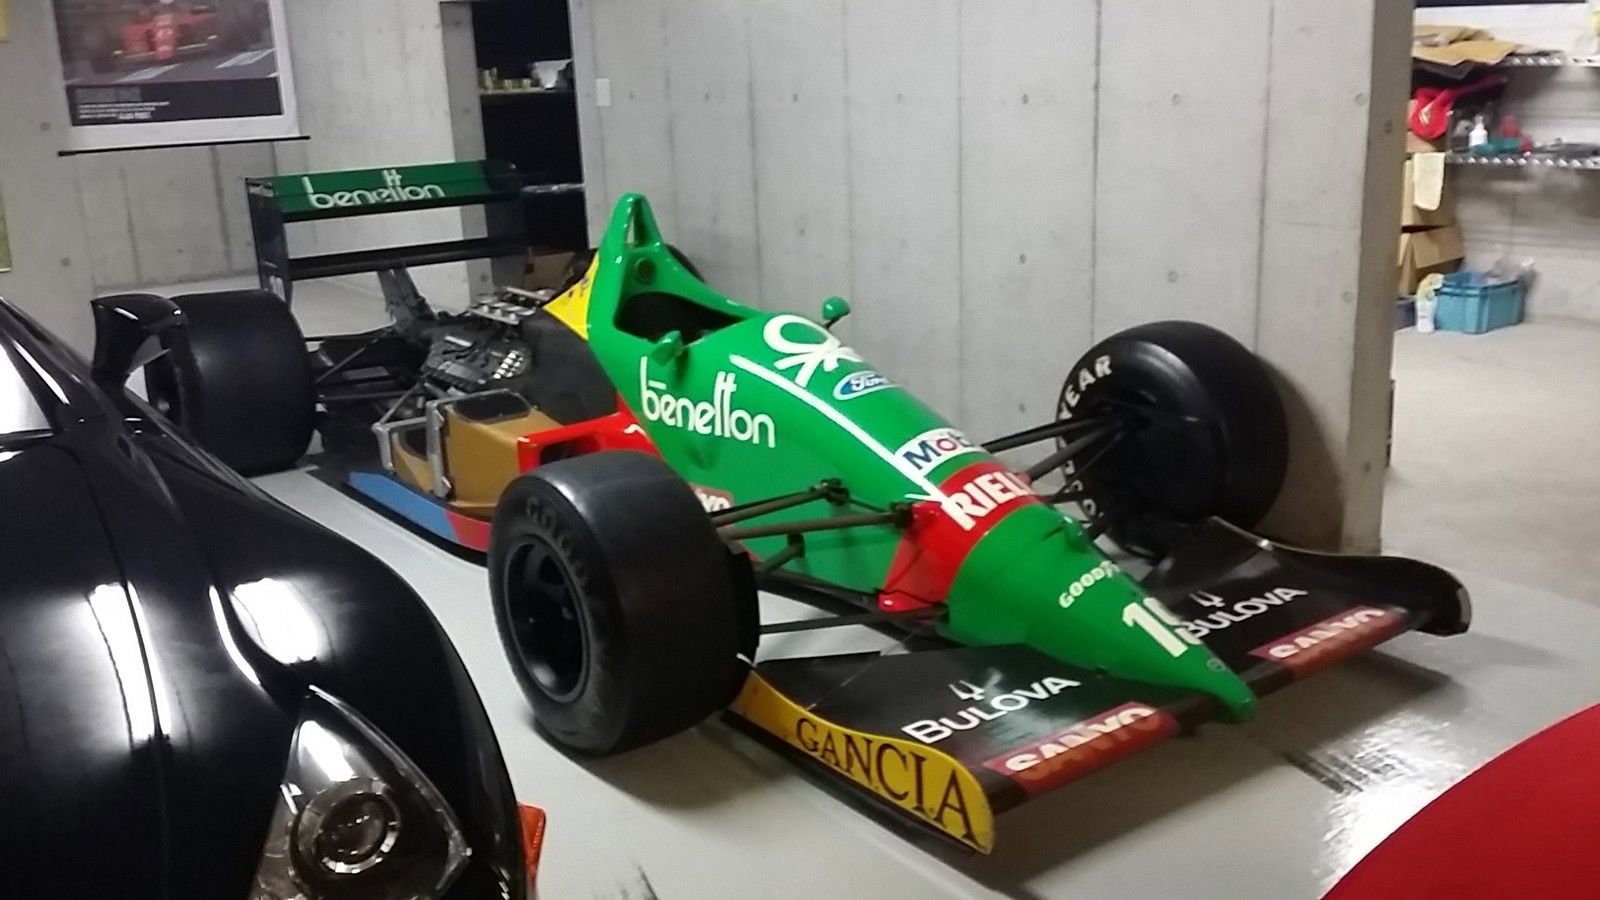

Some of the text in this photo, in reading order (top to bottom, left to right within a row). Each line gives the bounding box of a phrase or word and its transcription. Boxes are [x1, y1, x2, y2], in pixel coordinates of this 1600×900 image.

[302, 169, 445, 208] benetton
[640, 356, 775, 448] benetton
[1179, 586, 1308, 639] BULOVA
[901, 676, 1081, 744] BULOVA
[1005, 707, 1161, 779] SANYO
[796, 717, 981, 848] GANCIA
